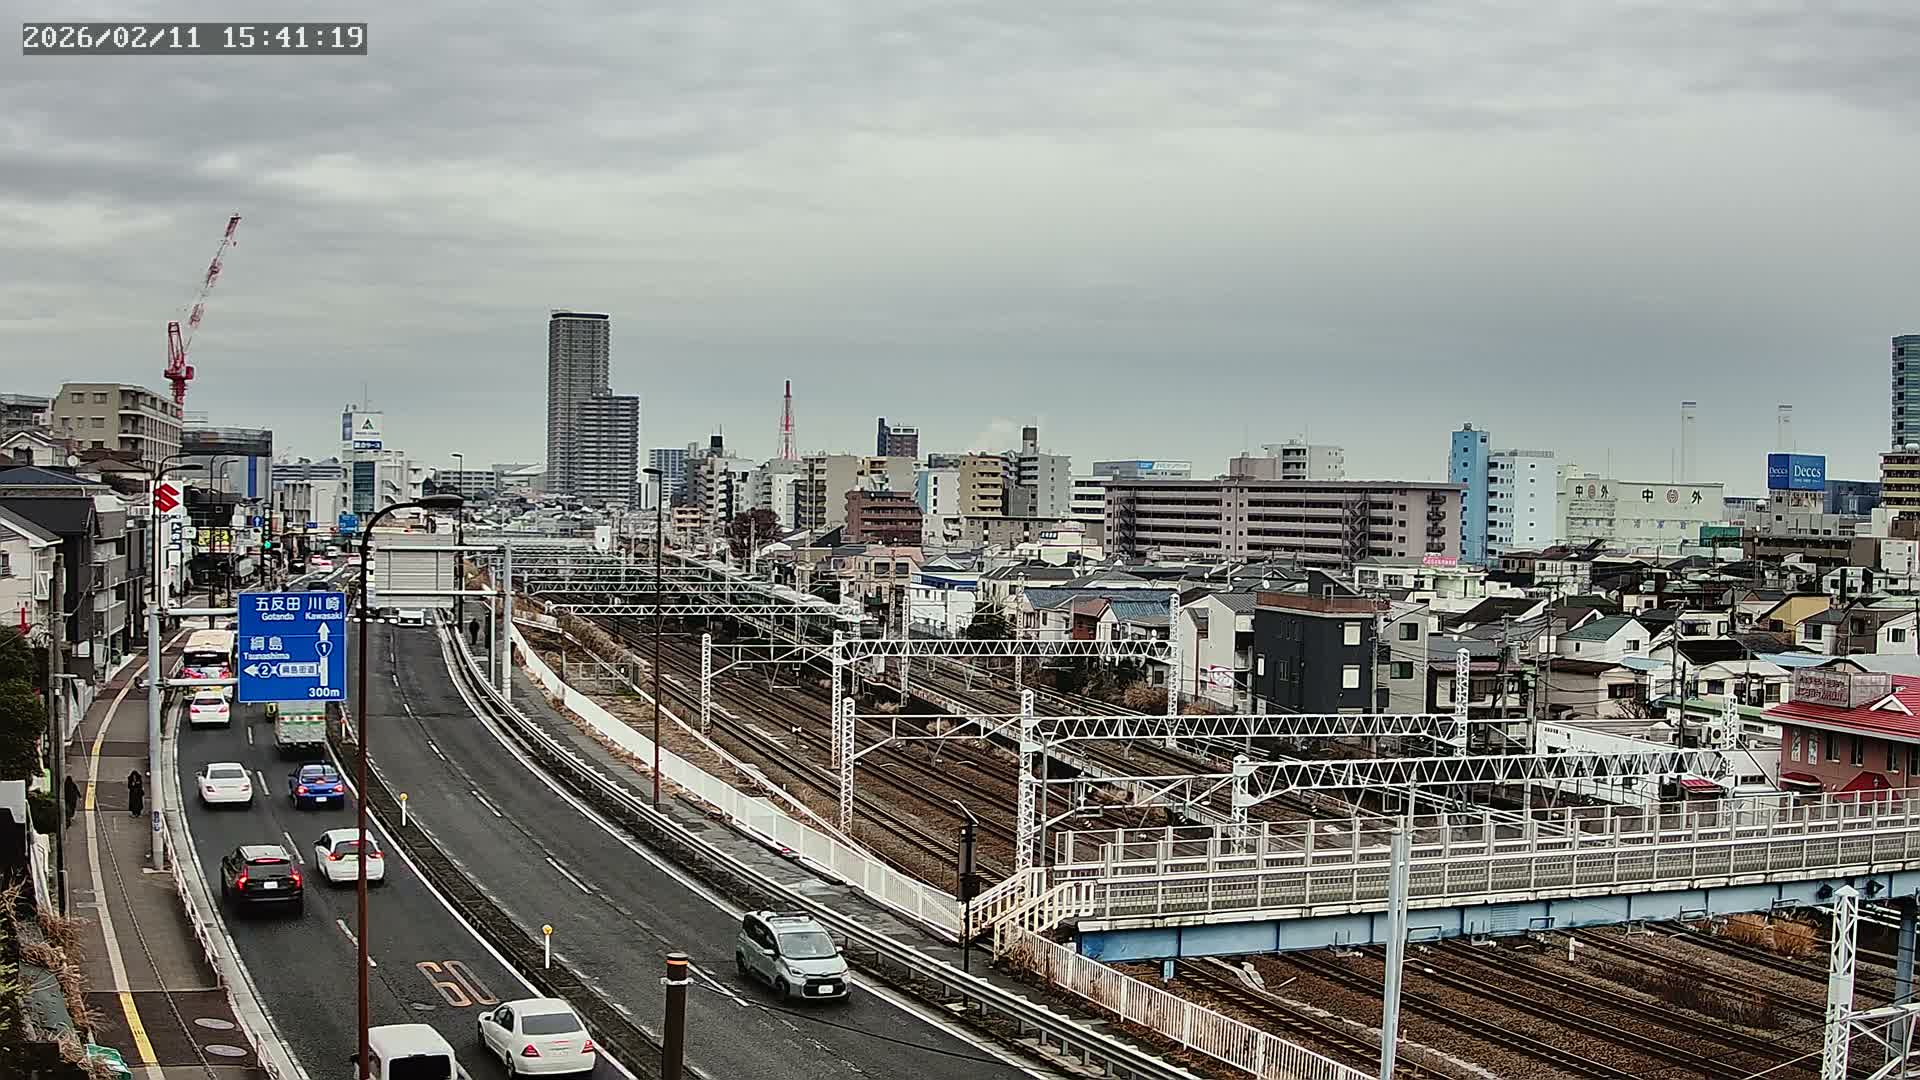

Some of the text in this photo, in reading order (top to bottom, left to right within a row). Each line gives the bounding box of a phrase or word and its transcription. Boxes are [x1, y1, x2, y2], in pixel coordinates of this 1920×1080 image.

[255, 597, 340, 611] 五反田 川崎
[261, 612, 343, 621] Gotanda Kawasaki
[320, 643, 327, 653] 1
[261, 665, 269, 675] 2
[308, 687, 340, 697] 300m
[416, 960, 500, 1007] 60
